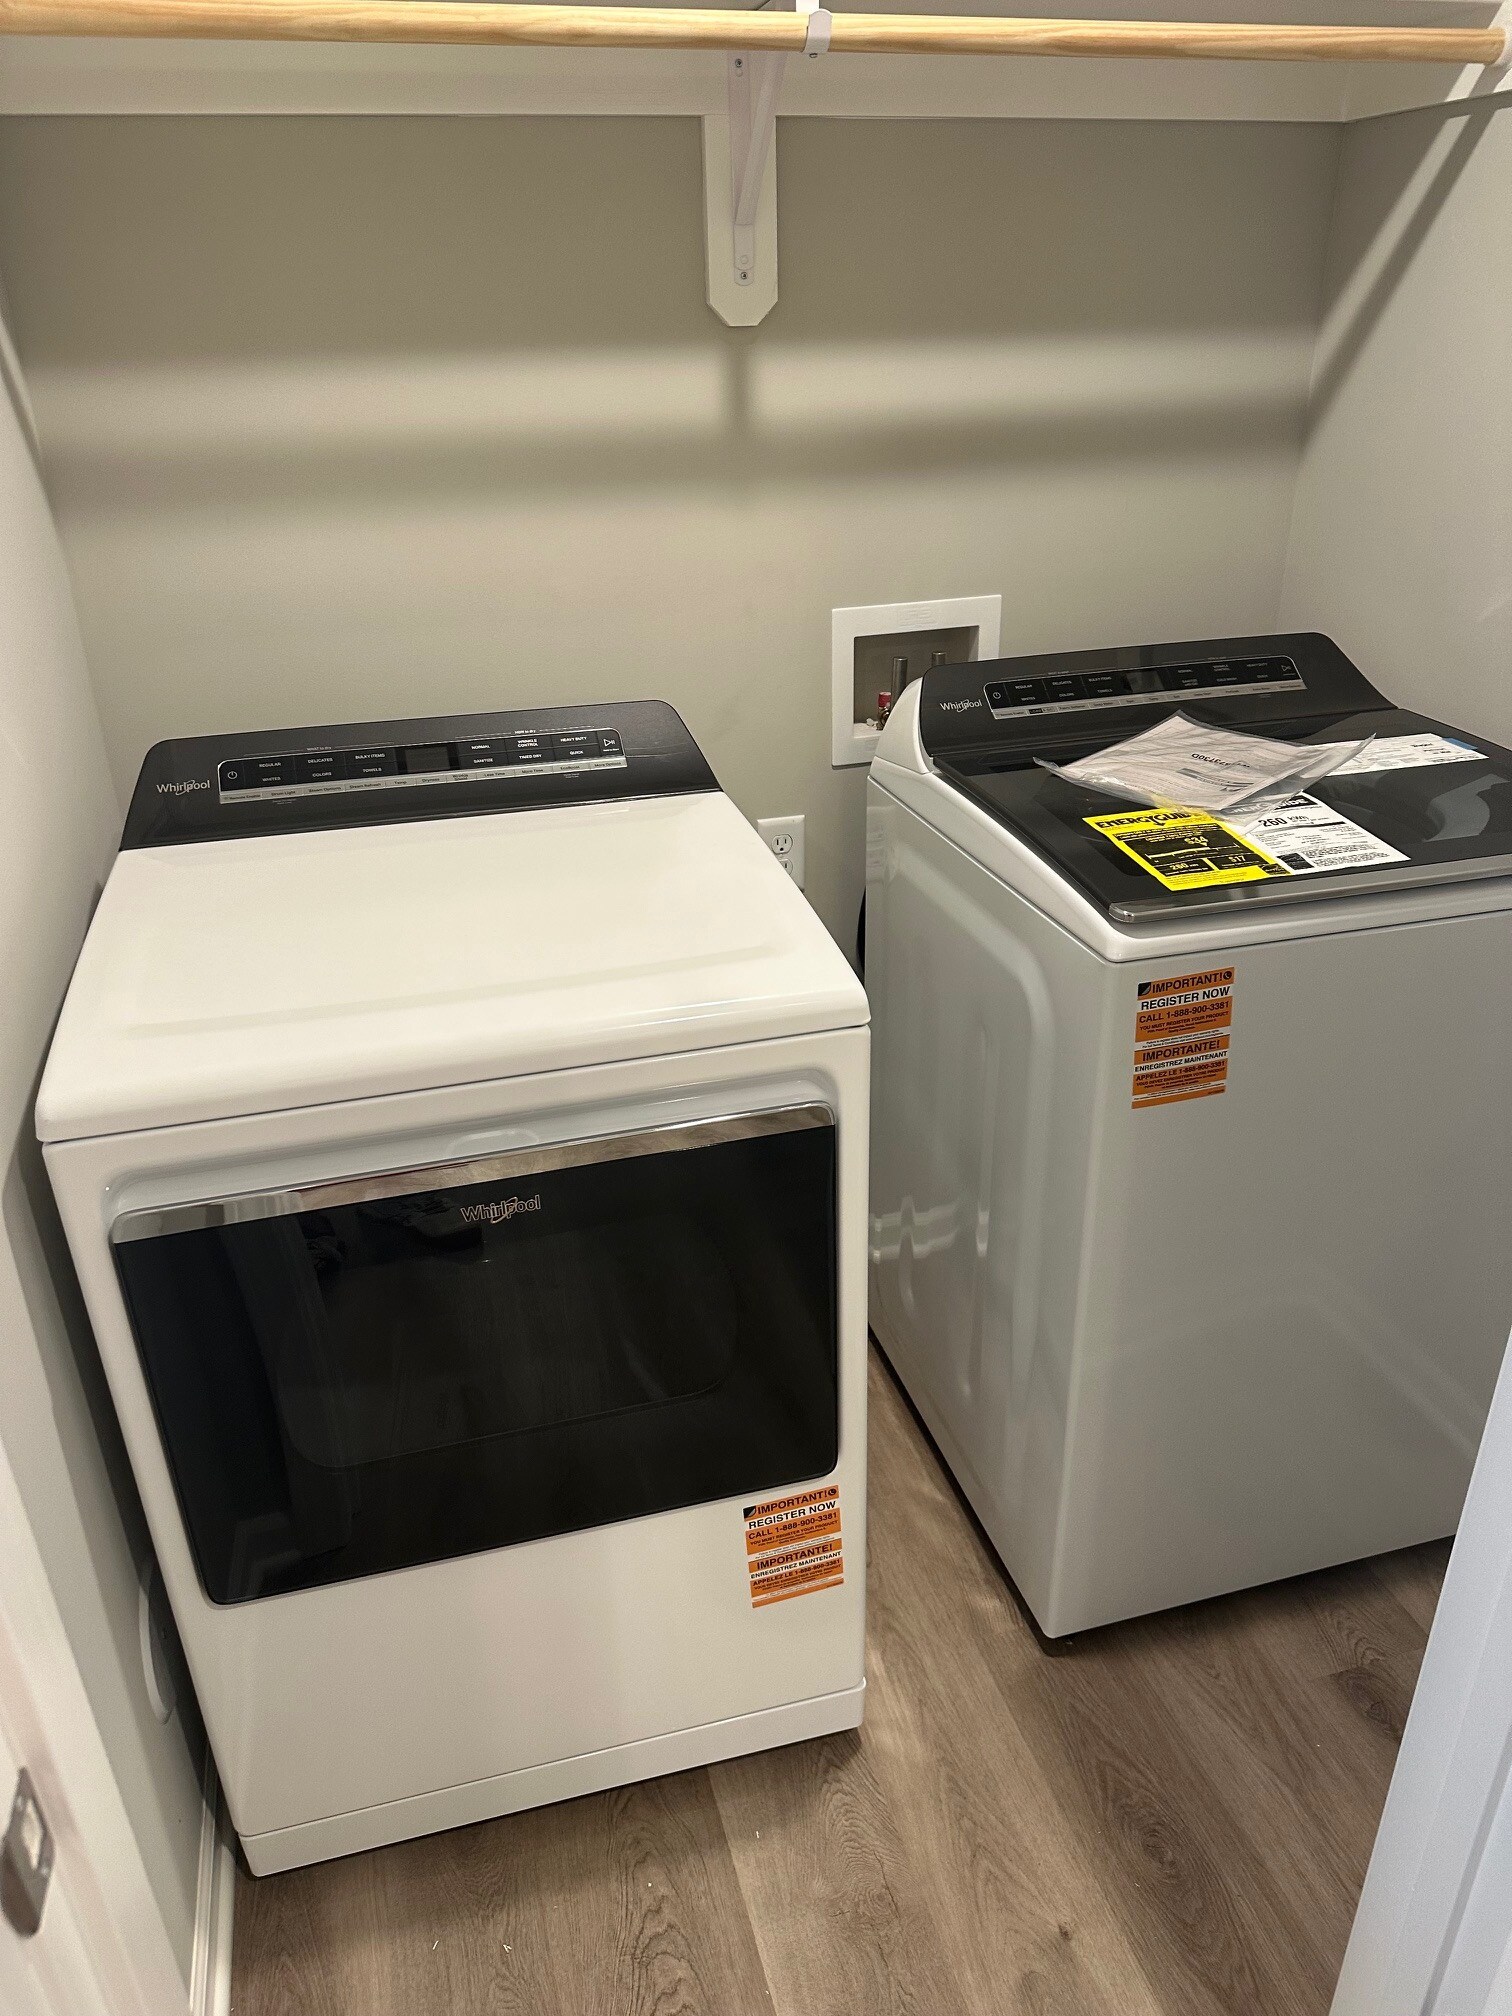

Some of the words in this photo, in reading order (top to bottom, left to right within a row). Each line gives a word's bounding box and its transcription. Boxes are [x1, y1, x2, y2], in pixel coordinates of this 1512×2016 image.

[940, 699, 982, 712] Whirlpool
[156, 779, 211, 796] Whirlpool
[1257, 816, 1288, 827] 260
[1152, 972, 1223, 994] IMPORTANT!
[1141, 992, 1200, 1010] REGISTER
[1202, 986, 1231, 999] NOW
[1139, 1013, 1164, 1024] CALL
[1166, 1000, 1229, 1019] 1-888-900-3381
[1166, 1017, 1191, 1027] REGISTER
[1205, 1011, 1229, 1019] PRODUCT
[1134, 1058, 1183, 1072] ENREGISTREZ
[1183, 1050, 1228, 1064] MAINTENANT
[1142, 1040, 1220, 1062] IMPORTANTE!
[1135, 1071, 1168, 1081] APPELEZ
[460, 1194, 541, 1224] Whirlpool
[757, 1490, 828, 1514] IMPORTANT!
[748, 1508, 806, 1529] REGISTER
[809, 1500, 837, 1514] NOW
[748, 1529, 773, 1540] CALL
[774, 1512, 837, 1533] 1-888-900-3381
[775, 1530, 800, 1539] REGISTER
[814, 1520, 838, 1529] PRODUCT
[750, 1562, 798, 1579] ENREGISTREZ
[798, 1551, 841, 1567] MAINTENANT
[756, 1543, 833, 1570] IMPORTANTE!
[752, 1574, 784, 1586] APPELEZ
